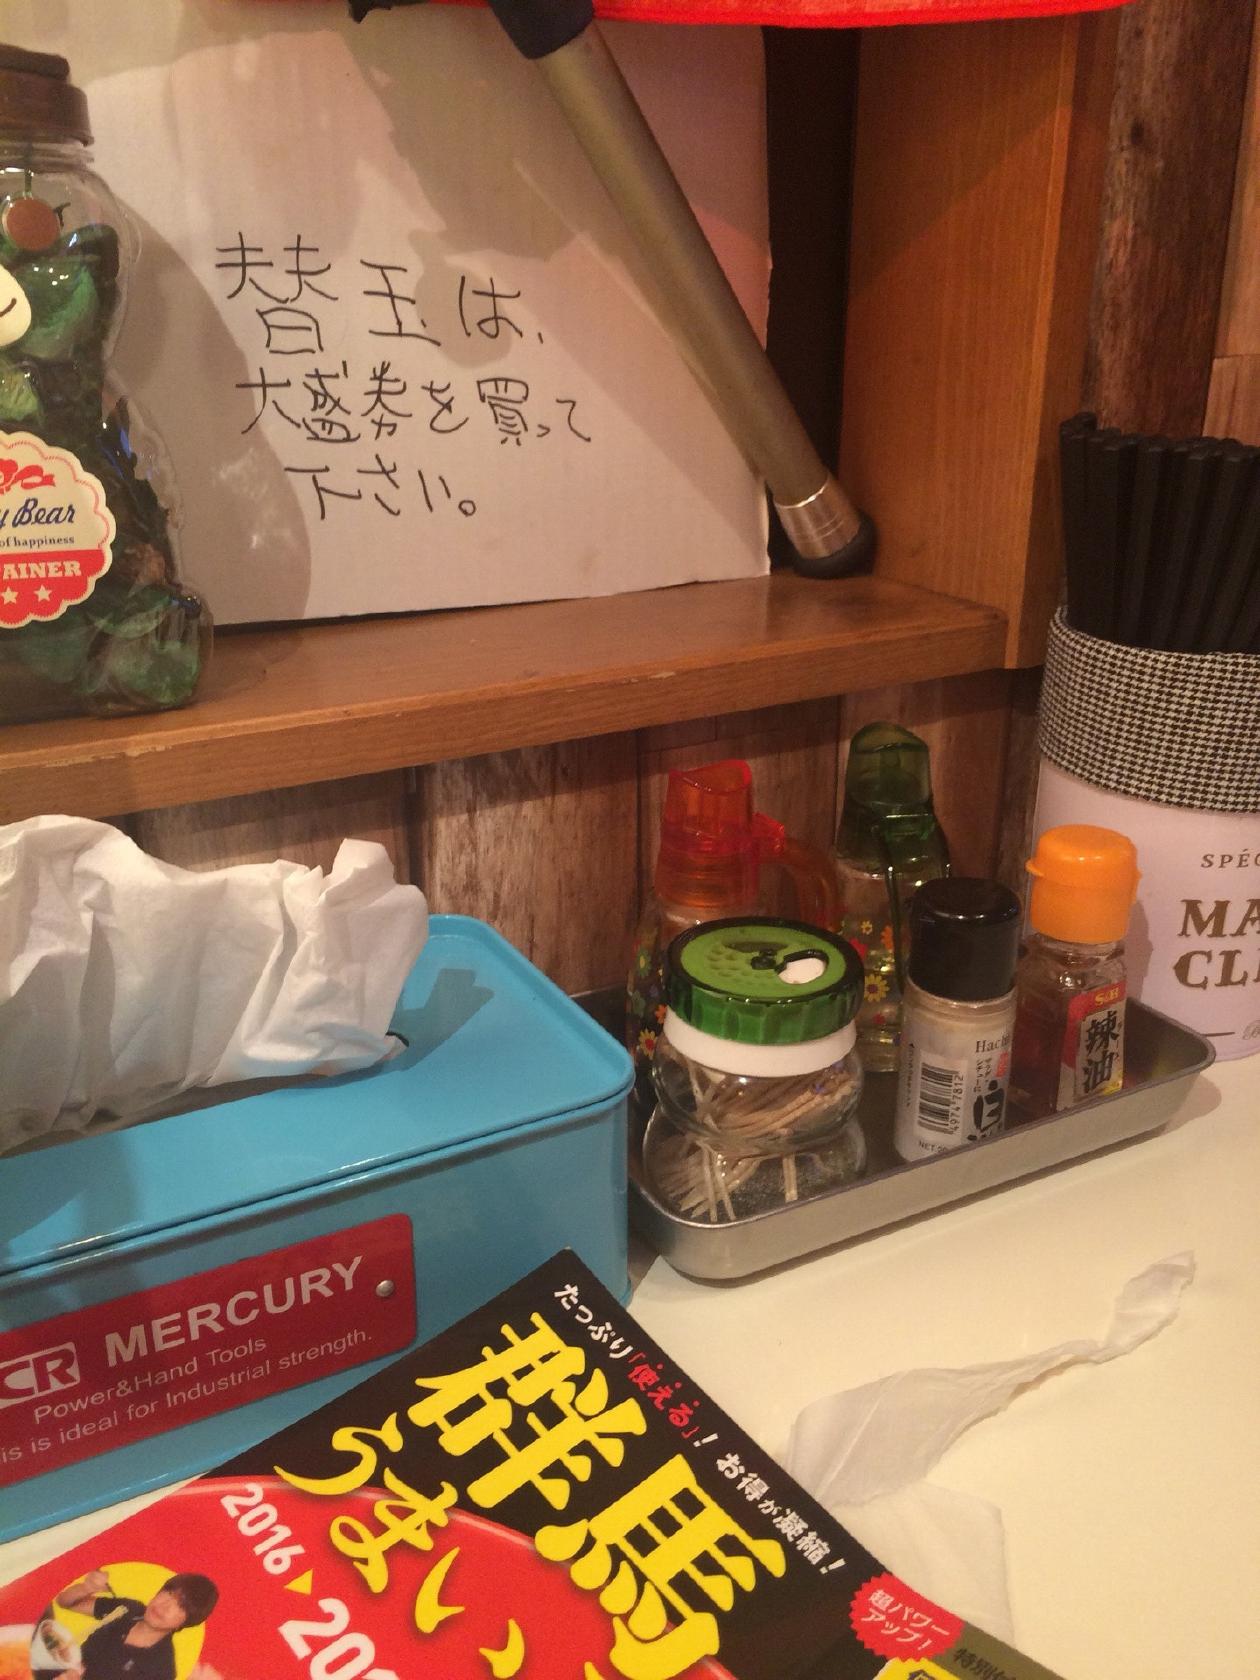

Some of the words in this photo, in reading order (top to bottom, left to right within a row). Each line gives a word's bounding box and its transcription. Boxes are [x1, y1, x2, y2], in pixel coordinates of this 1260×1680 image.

[11, 497, 76, 528] Bear
[14, 535, 75, 550] happiness
[2, 560, 82, 580] AINER
[1172, 949, 1260, 990] CL
[1082, 1010, 1120, 1094] 辣油
[105, 1255, 364, 1368] MERCURY
[31, 1436, 52, 1454] is
[59, 1410, 119, 1444] ideal
[127, 1401, 160, 1421] for
[166, 1362, 271, 1408] Industrial
[278, 1333, 373, 1371] strength.
[33, 1356, 198, 1425] Power&Hand
[207, 1335, 268, 1367] Tools
[220, 1482, 306, 1576] 2016
[407, 1311, 786, 1680] 群馬
[277, 1597, 402, 1680] 20
